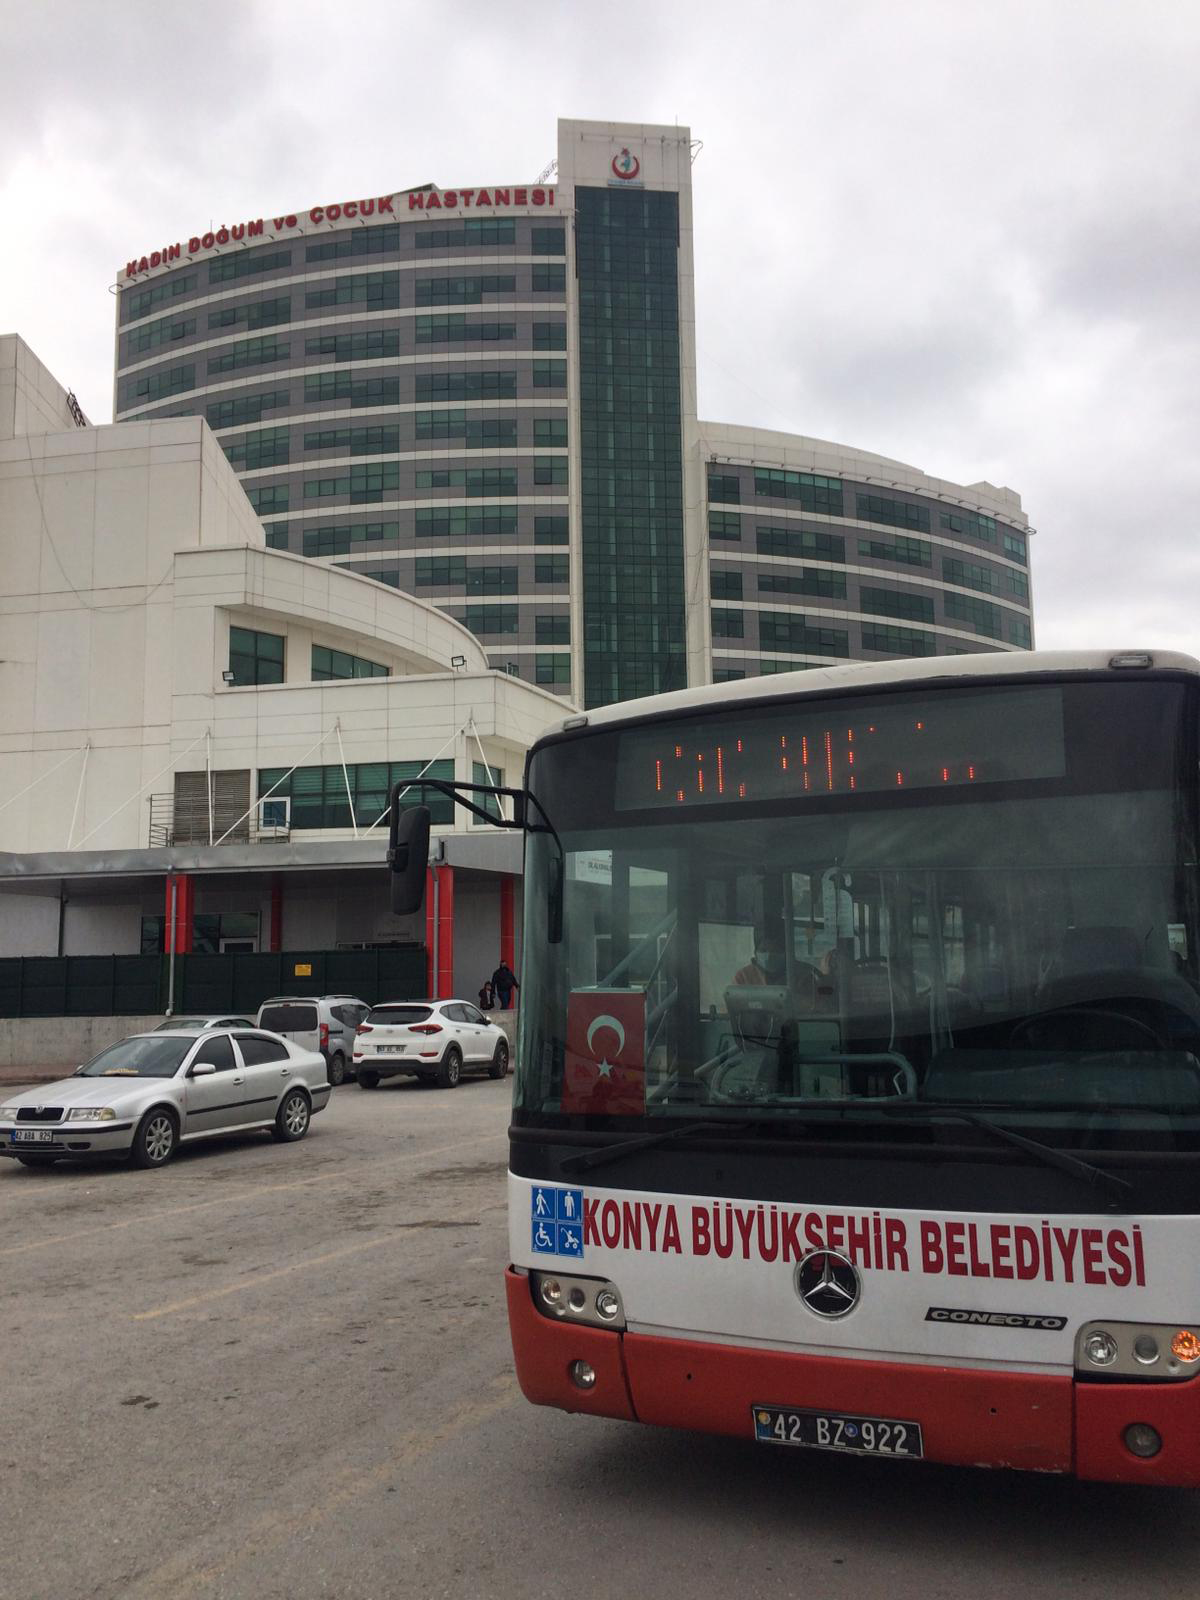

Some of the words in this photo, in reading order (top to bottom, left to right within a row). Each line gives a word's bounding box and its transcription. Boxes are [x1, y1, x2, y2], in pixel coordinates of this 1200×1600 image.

[126, 242, 180, 278] KADIN
[189, 218, 264, 254] DOĞUM
[273, 215, 298, 231] ve
[309, 196, 394, 224] ÇOCUK
[583, 1198, 682, 1254] KONYA
[920, 1219, 1146, 1287] BELEDİYESİ
[931, 1310, 1062, 1328] CONECTO
[774, 1413, 801, 1442] 42
[816, 1417, 846, 1447] BZ
[861, 1422, 909, 1453] 922
